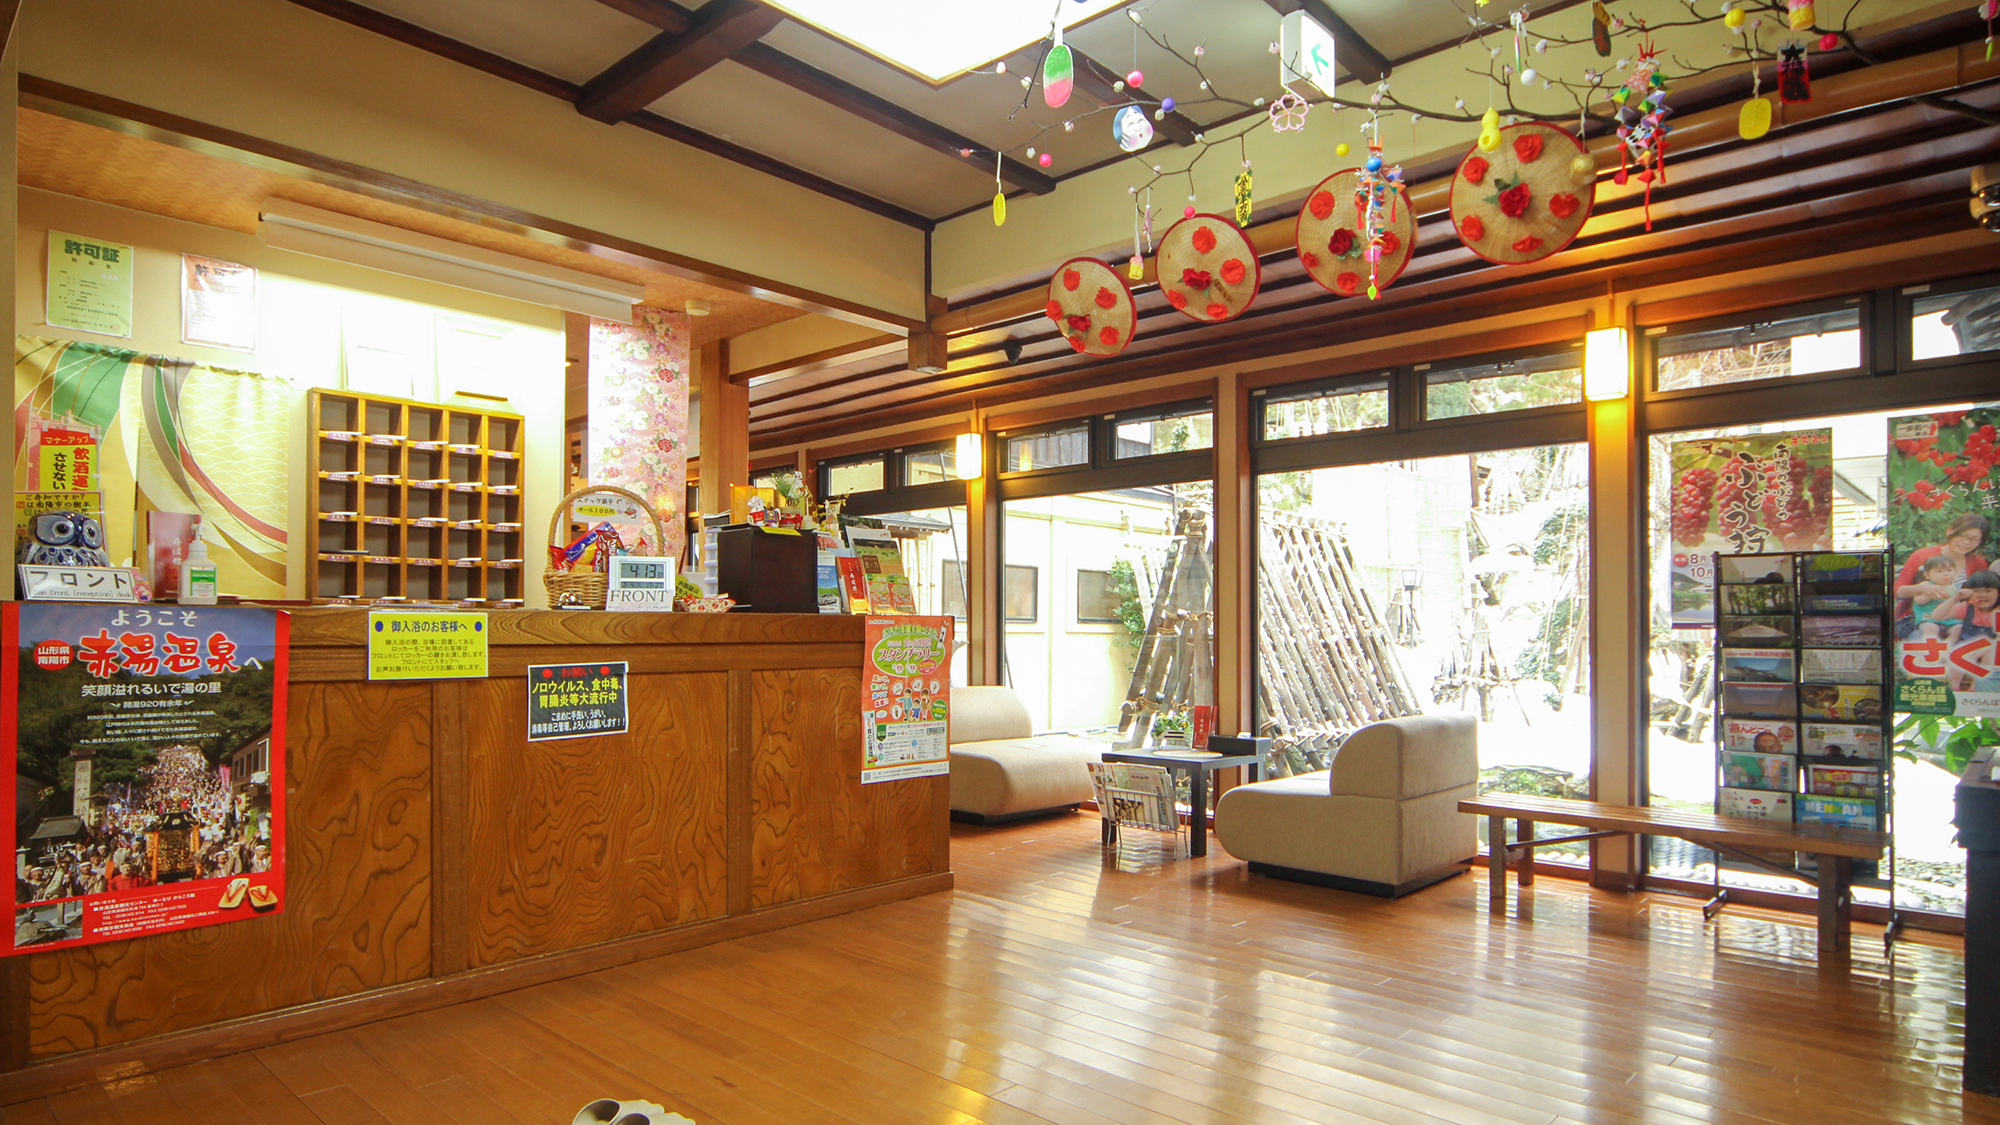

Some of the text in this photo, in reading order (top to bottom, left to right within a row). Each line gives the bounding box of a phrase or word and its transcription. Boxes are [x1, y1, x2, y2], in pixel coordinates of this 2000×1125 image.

[64, 239, 120, 263] 許可証
[45, 435, 89, 445] マナーアップ
[53, 452, 67, 490] させない
[72, 446, 90, 491] 飲酒運
[1773, 443, 1793, 520] 南陽のぶどう
[1725, 452, 1771, 554] ぶどう狩
[30, 570, 127, 589] フロント
[610, 590, 669, 603] FRONT
[111, 609, 198, 627] ようこそ
[391, 620, 468, 633] 御入浴のお客様へ
[38, 646, 70, 655] 山形県
[77, 628, 263, 679] 赤湯温泉へ
[878, 647, 941, 662] スタンプラリー
[38, 656, 70, 665] 南陽市
[561, 667, 594, 678] お願い
[81, 682, 222, 697] 笑顔溢れるいで湯の里
[532, 677, 623, 694] ノロウイルス、食中毒、
[1901, 685, 1947, 694] さくらんぼ
[539, 691, 618, 709] 胃腸炎等大流行中
